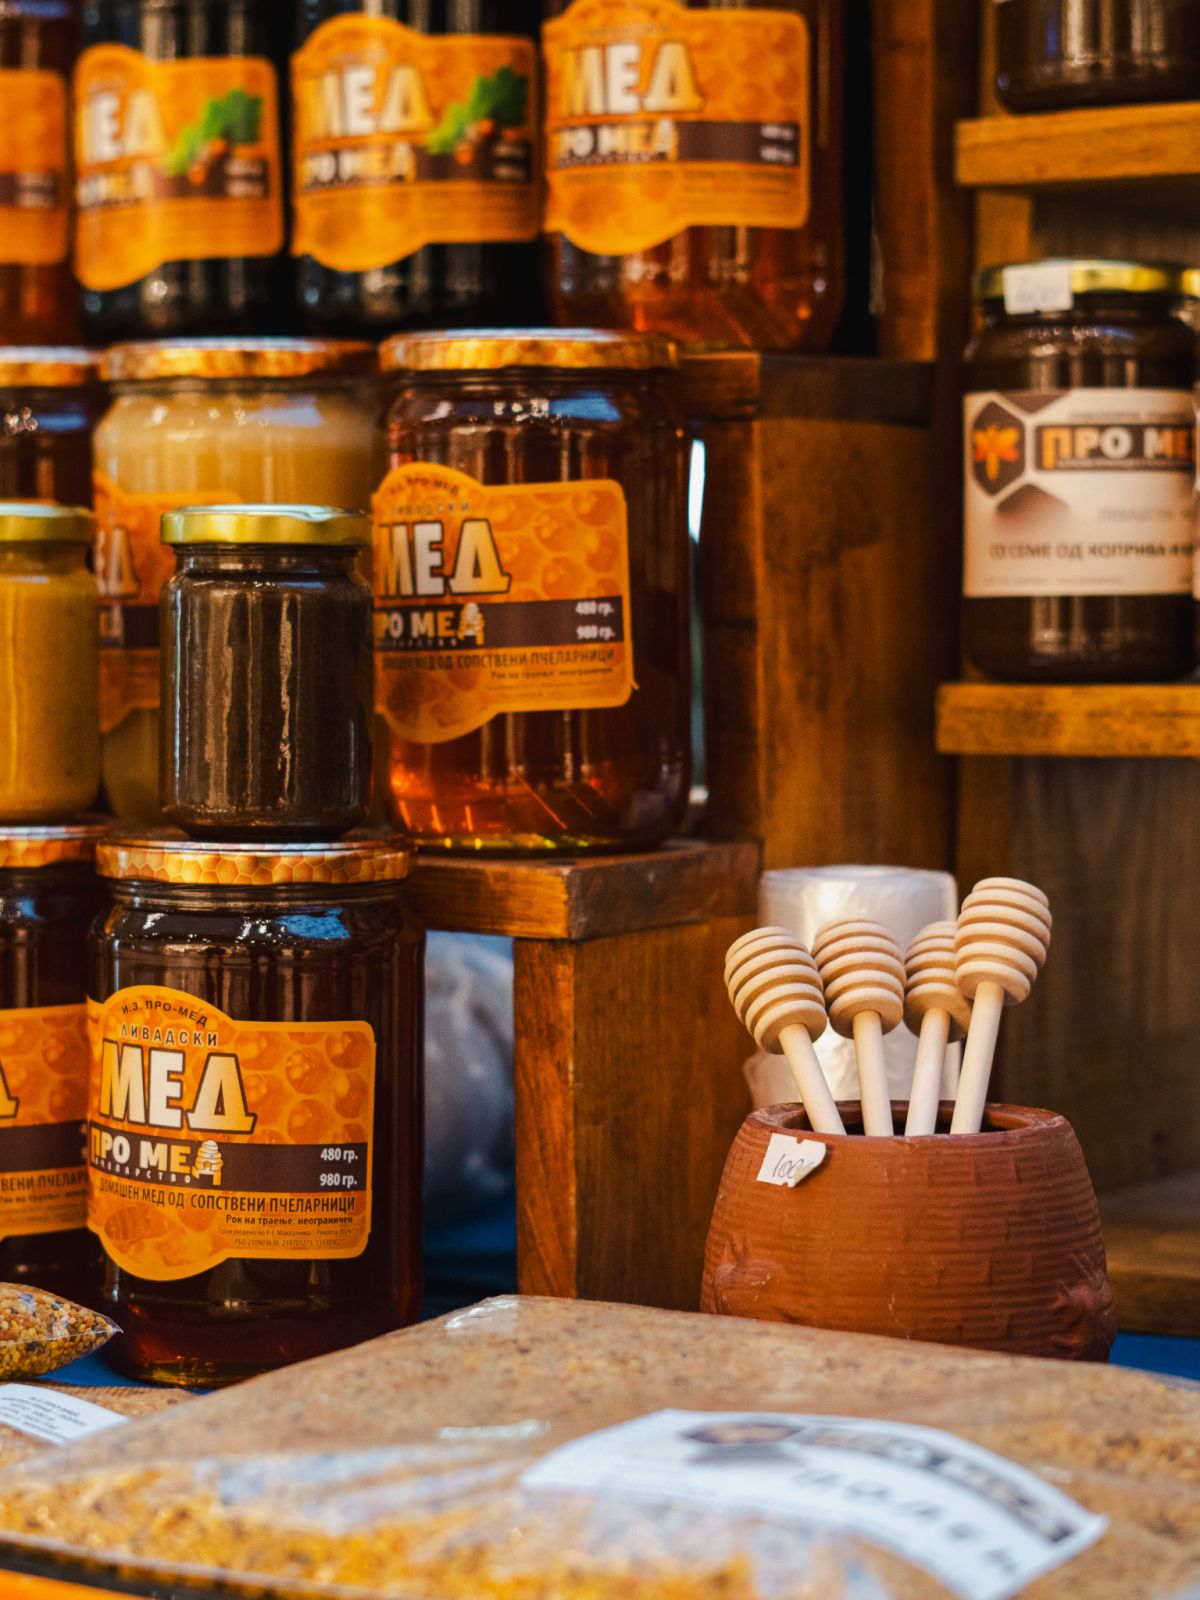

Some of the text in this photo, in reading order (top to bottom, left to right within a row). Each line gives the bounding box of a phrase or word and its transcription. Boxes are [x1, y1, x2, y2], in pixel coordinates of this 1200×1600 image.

[84, 90, 167, 163] ЕД
[1043, 426, 1132, 471] ПРО
[379, 518, 512, 597] МЕД
[122, 1000, 208, 1028] И.З. ПРО-МЕД
[121, 1023, 217, 1047] ЛИВАДСКИ
[99, 1038, 258, 1134] МЕД
[91, 1126, 223, 1186] ПРО МЕД
[320, 1147, 358, 1164] 480 гр.
[99, 1176, 140, 1201] ДОМАШЕН
[142, 1187, 166, 1207] МЕД
[168, 1191, 185, 1209] ОД
[190, 1193, 266, 1213] СОПСТВЕНИ
[270, 1195, 355, 1214] ПЧЕЛАРНИЦИ
[320, 1172, 358, 1189] 980 гр.
[226, 1214, 242, 1224] Рок
[245, 1216, 255, 1225] на
[298, 1215, 353, 1227] неограничен
